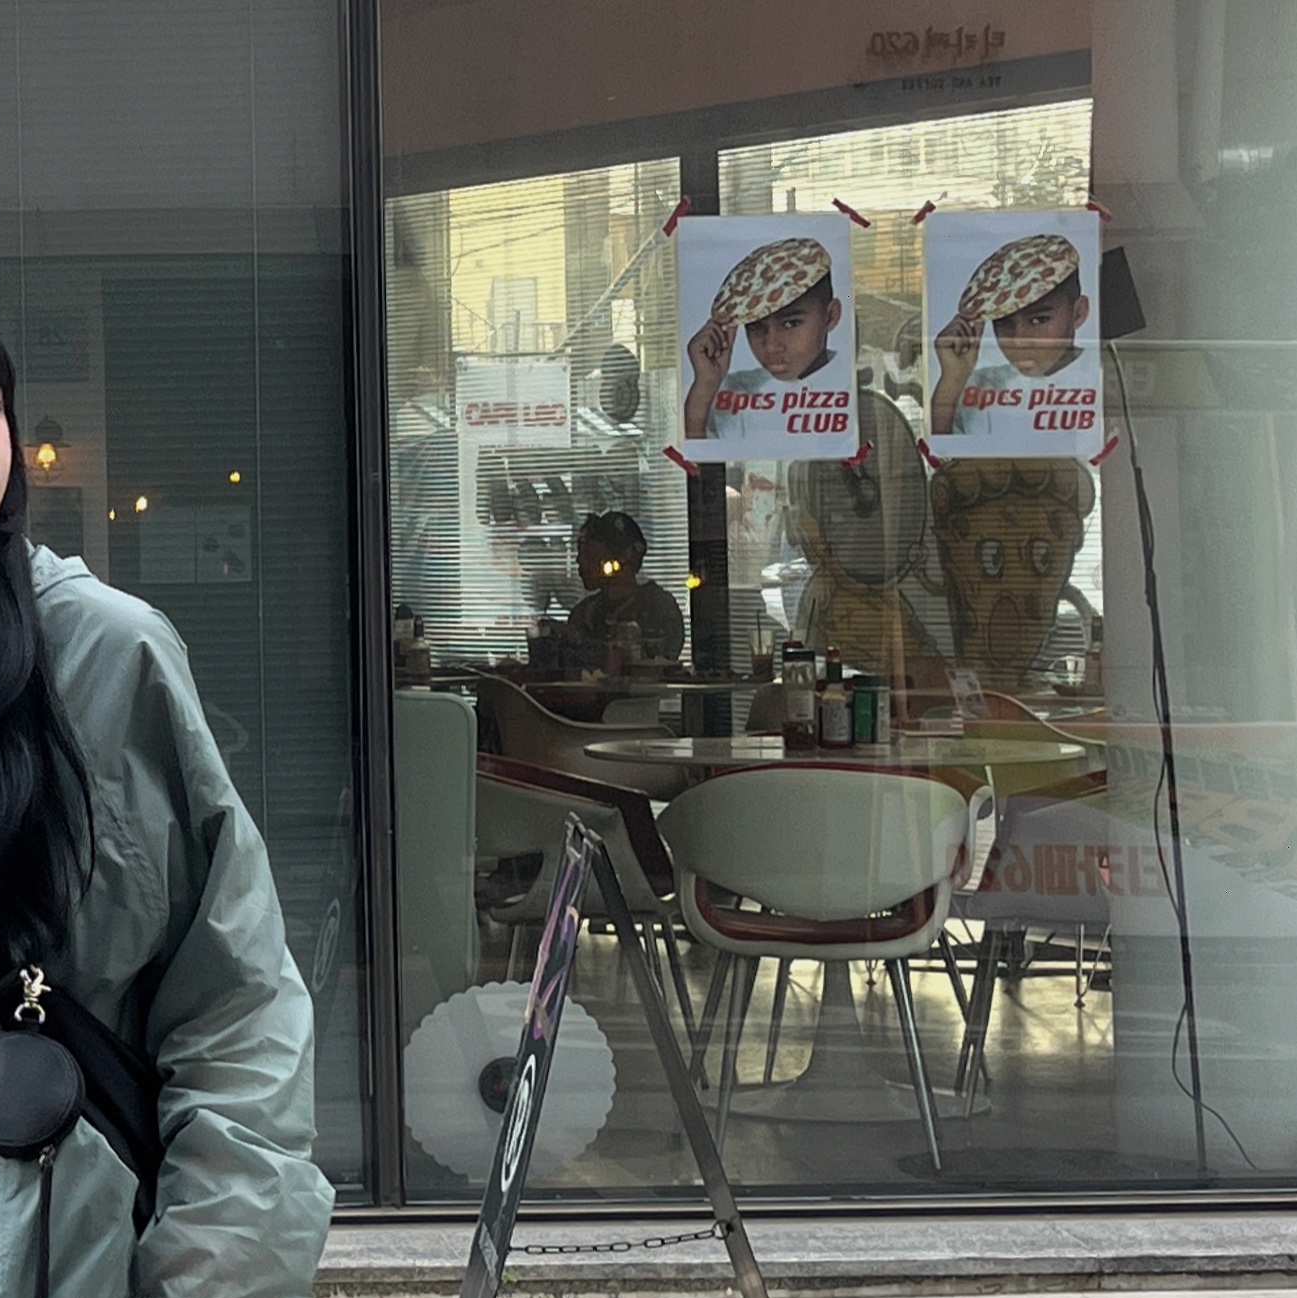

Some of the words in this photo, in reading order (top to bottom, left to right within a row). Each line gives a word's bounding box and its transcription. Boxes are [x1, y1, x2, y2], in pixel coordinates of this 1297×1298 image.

[714, 389, 776, 415] 8pcs
[781, 386, 850, 413] pizza
[961, 387, 1024, 412] 8pcs
[1028, 383, 1098, 411] pizza
[786, 411, 850, 434] CLUB
[1032, 409, 1097, 432] CLUB
